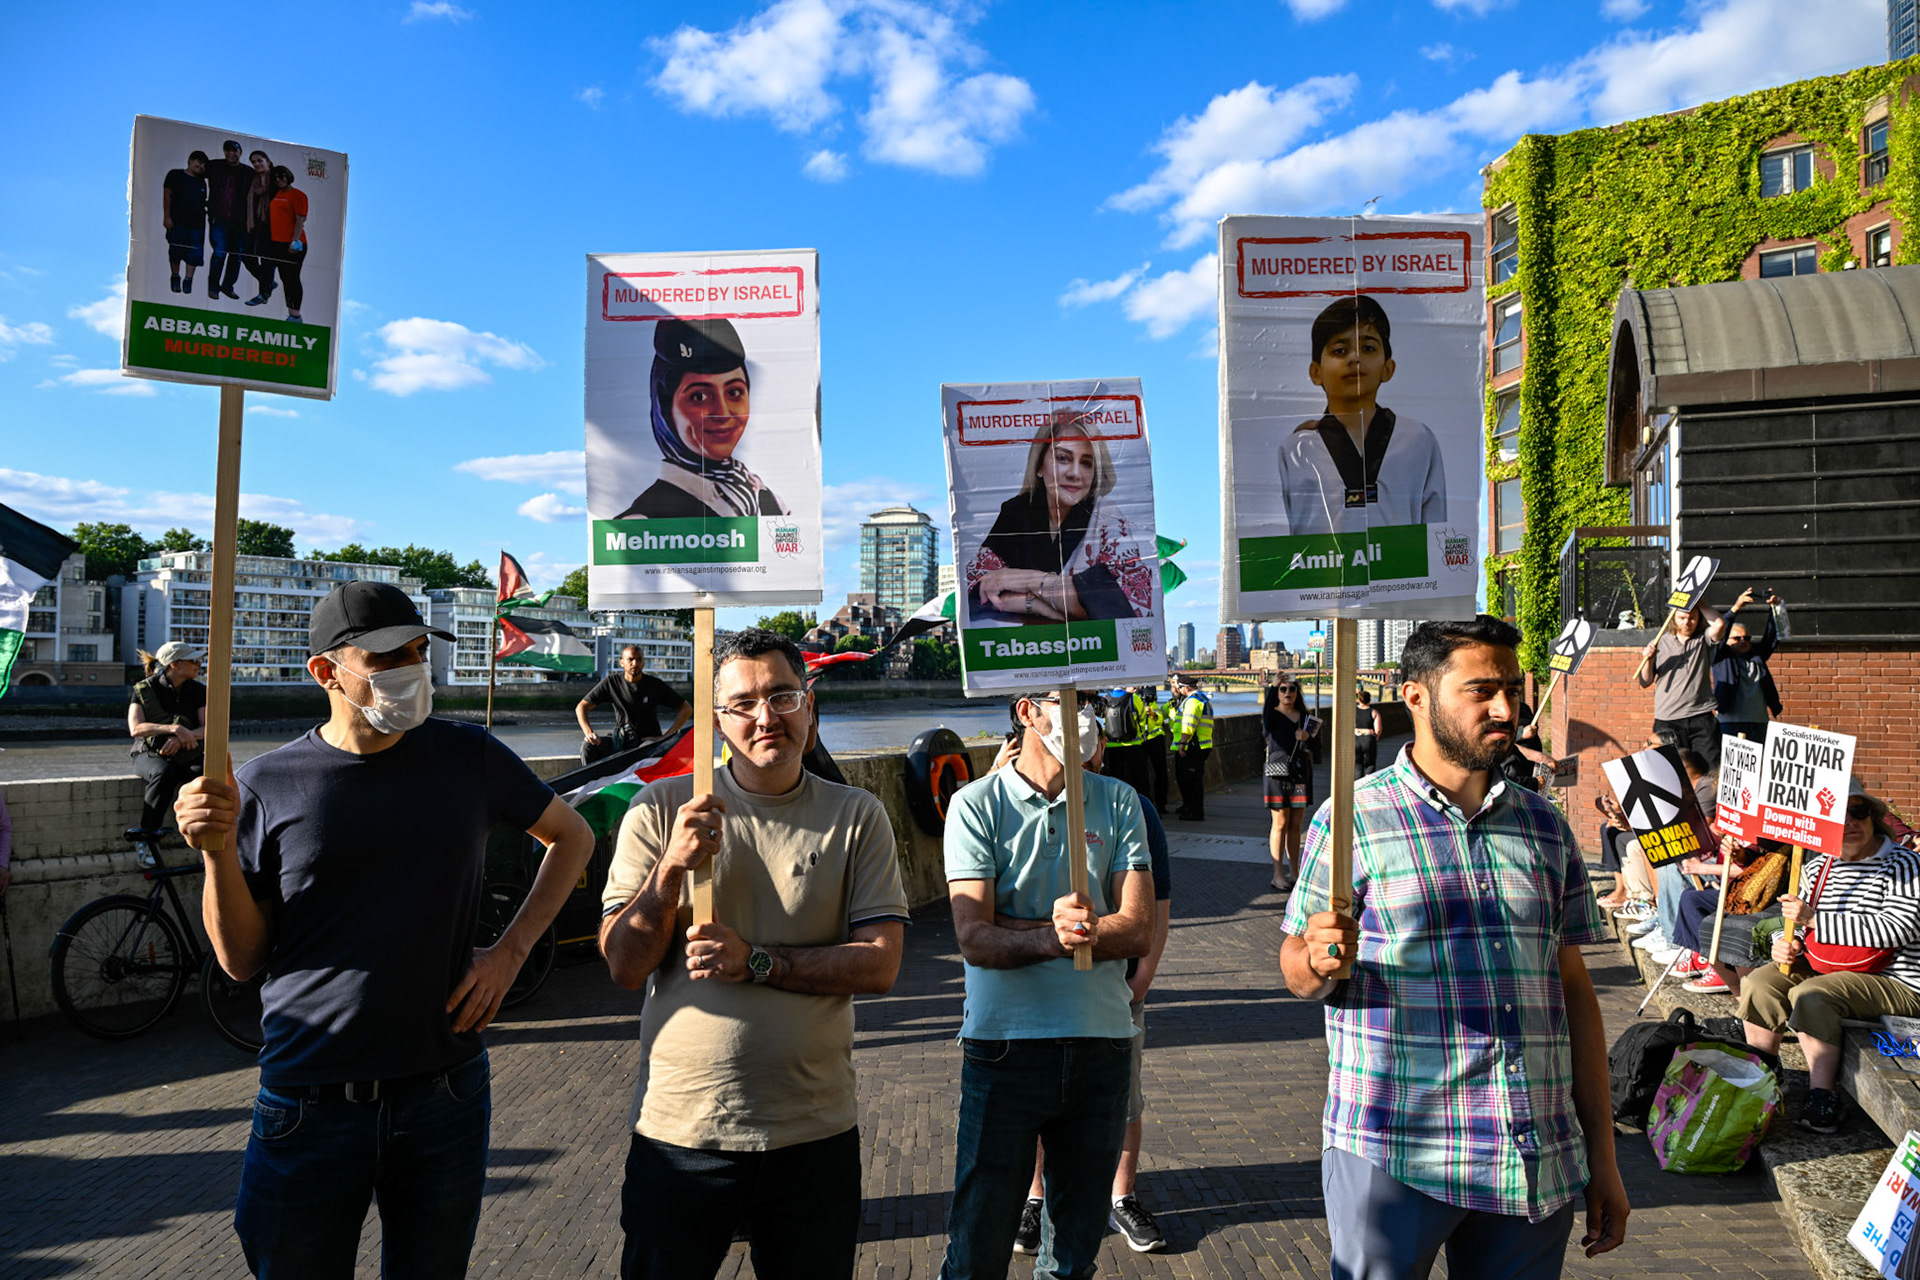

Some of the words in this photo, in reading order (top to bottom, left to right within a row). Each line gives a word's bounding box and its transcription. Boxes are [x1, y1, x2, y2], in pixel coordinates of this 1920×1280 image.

[1252, 257, 1355, 276] MURDERED
[1363, 255, 1387, 272] BY
[1392, 253, 1458, 272] ISRAEL
[615, 288, 705, 303] MURDERED
[709, 286, 730, 301] BY
[734, 285, 793, 300] ISRAEL
[144, 316, 228, 339] ABBASI
[236, 327, 318, 350] FAMILY
[165, 338, 296, 368] MURDERED!
[969, 413, 1052, 429] MURDERED
[1057, 412, 1077, 425] BY
[1081, 411, 1132, 425] ISRAEL
[605, 529, 745, 551] Mehrnoosh
[775, 543, 798, 552] WAR
[1290, 551, 1345, 570] Amir
[1351, 543, 1382, 566] Ali
[1445, 554, 1468, 566] WAR
[644, 565, 767, 575] www.iraniansagainstimposedwar.org
[1299, 579, 1438, 601] www.iraniansagainstimposedwar.org
[979, 636, 1102, 658] Tabassom
[1132, 642, 1153, 652] WAR
[1782, 728, 1812, 741] Socialist
[1813, 733, 1840, 746] Worker
[1724, 747, 1734, 766] NO
[1737, 750, 1757, 773] WAR
[1772, 736, 1799, 761] NO
[1805, 742, 1845, 771] WAR
[1722, 765, 1742, 788] WITH
[1770, 759, 1816, 789] WITH
[1720, 783, 1739, 807] IRAN
[1766, 781, 1809, 811] IRAN
[1764, 808, 1793, 826] Down
[1794, 815, 1816, 832] with
[1639, 831, 1661, 849] NO
[1659, 822, 1693, 843] WAR
[1762, 821, 1822, 847] imperialism
[1646, 845, 1669, 863] ON
[1665, 835, 1701, 857] IRAN
[1886, 1171, 1920, 1214] WAR!
[1862, 1221, 1889, 1256] THE
[1892, 1212, 1914, 1243] HS
